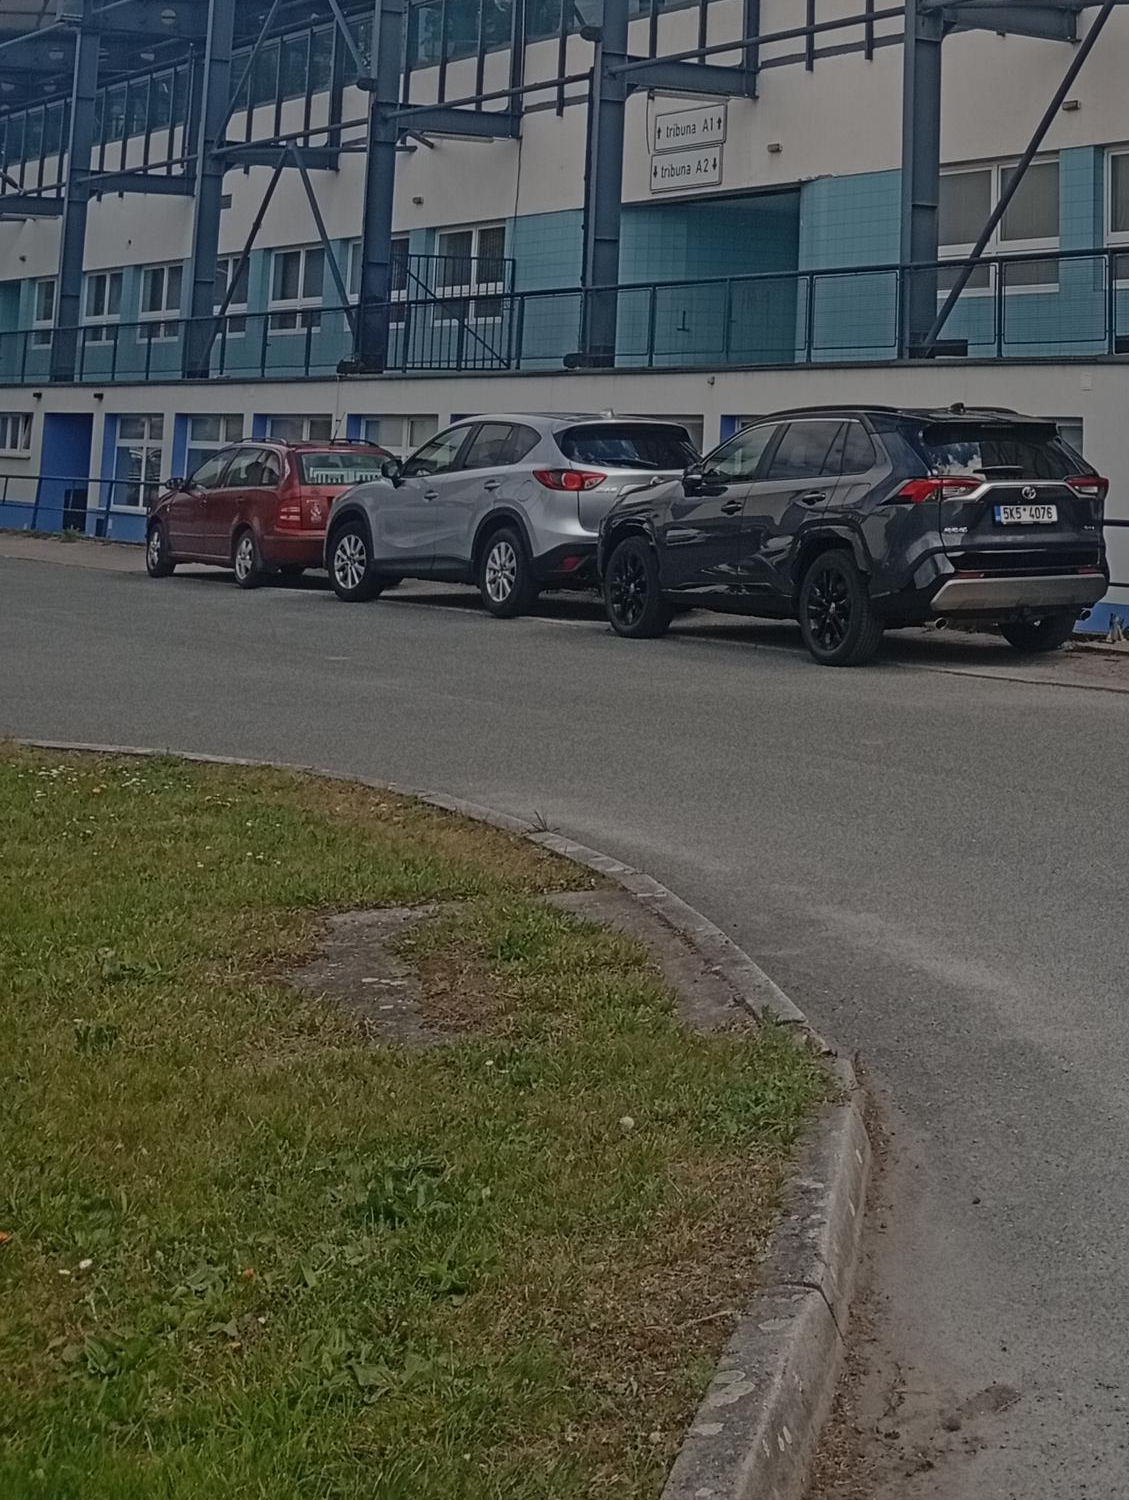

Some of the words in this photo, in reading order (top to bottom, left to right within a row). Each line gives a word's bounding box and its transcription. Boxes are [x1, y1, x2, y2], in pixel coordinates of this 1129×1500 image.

[666, 123, 696, 139] tribuna
[702, 117, 714, 133] A1
[661, 164, 691, 179] tribuna
